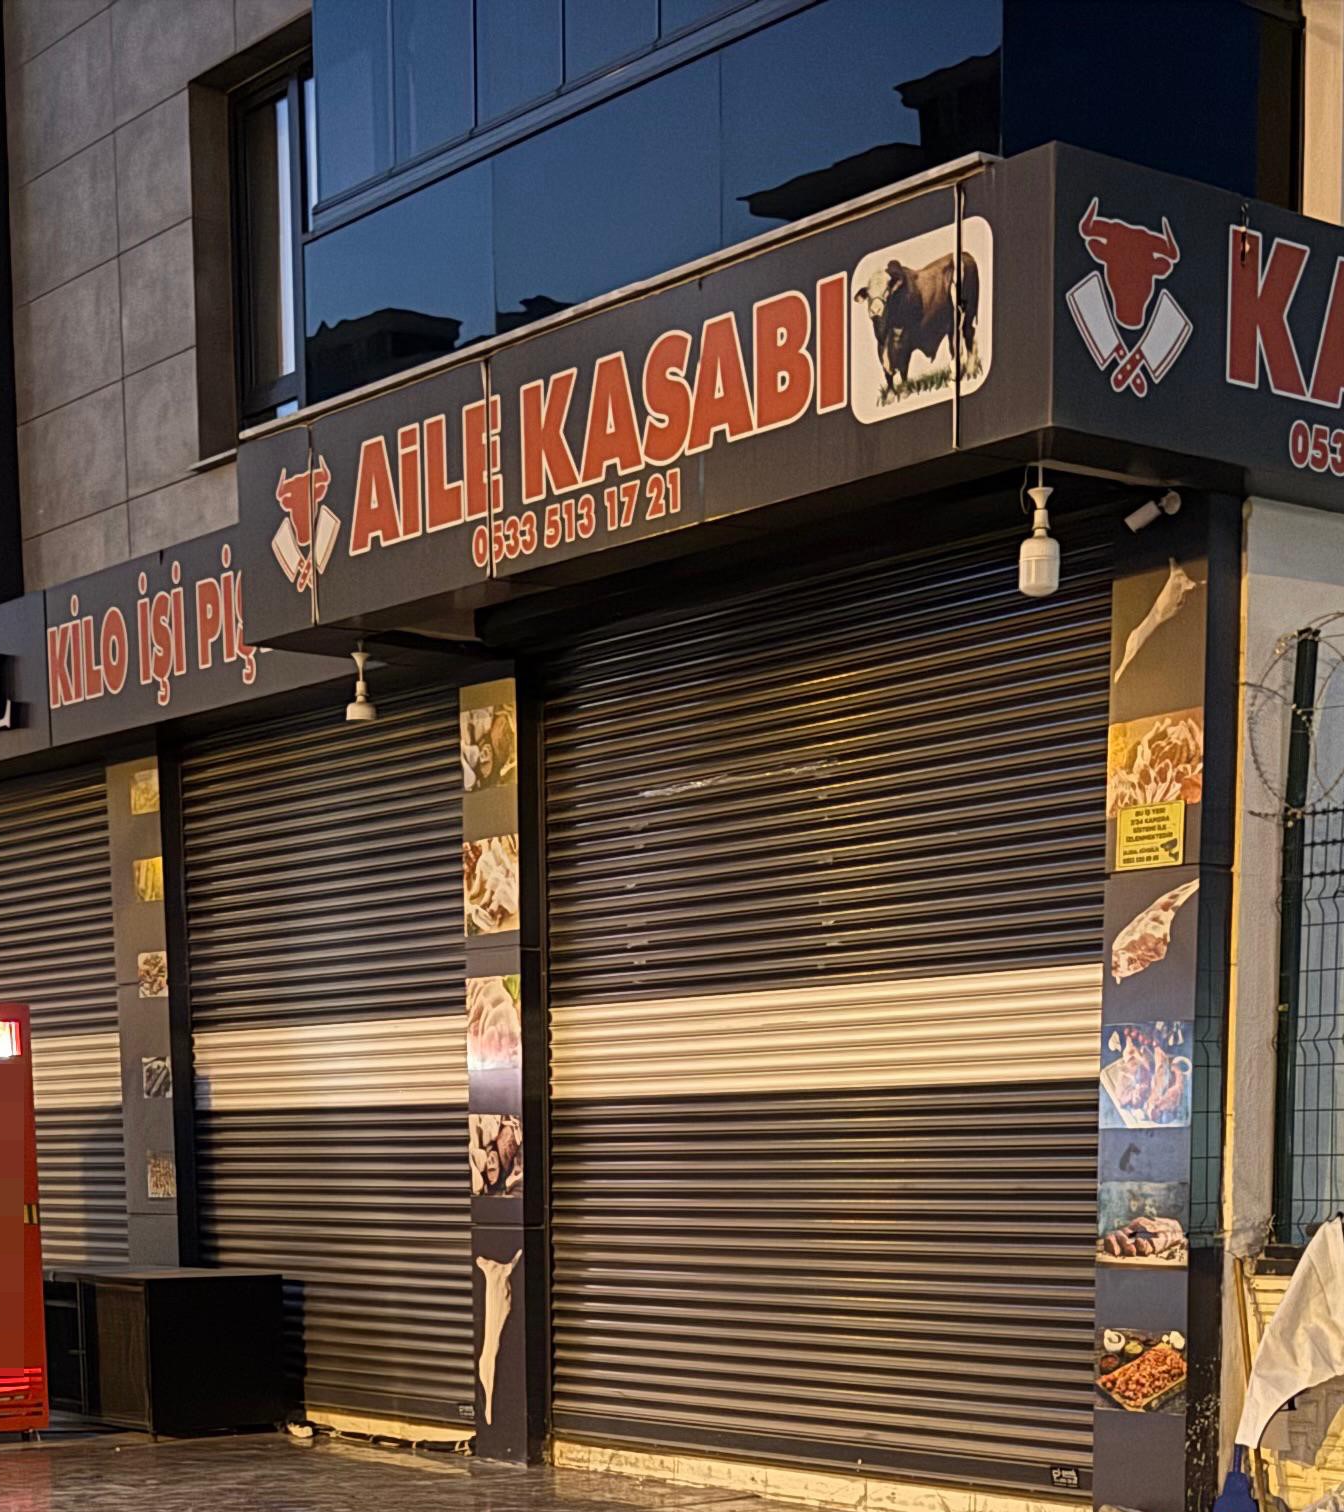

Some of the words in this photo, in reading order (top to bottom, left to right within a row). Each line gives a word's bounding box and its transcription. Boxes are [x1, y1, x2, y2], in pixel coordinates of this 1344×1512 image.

[520, 270, 850, 504] KASABI
[471, 511, 538, 569] 0533
[543, 496, 596, 547] 513
[605, 482, 639, 533] 17
[645, 467, 683, 518] 21
[47, 593, 129, 709] KİLO
[137, 560, 187, 706] İŞİ
